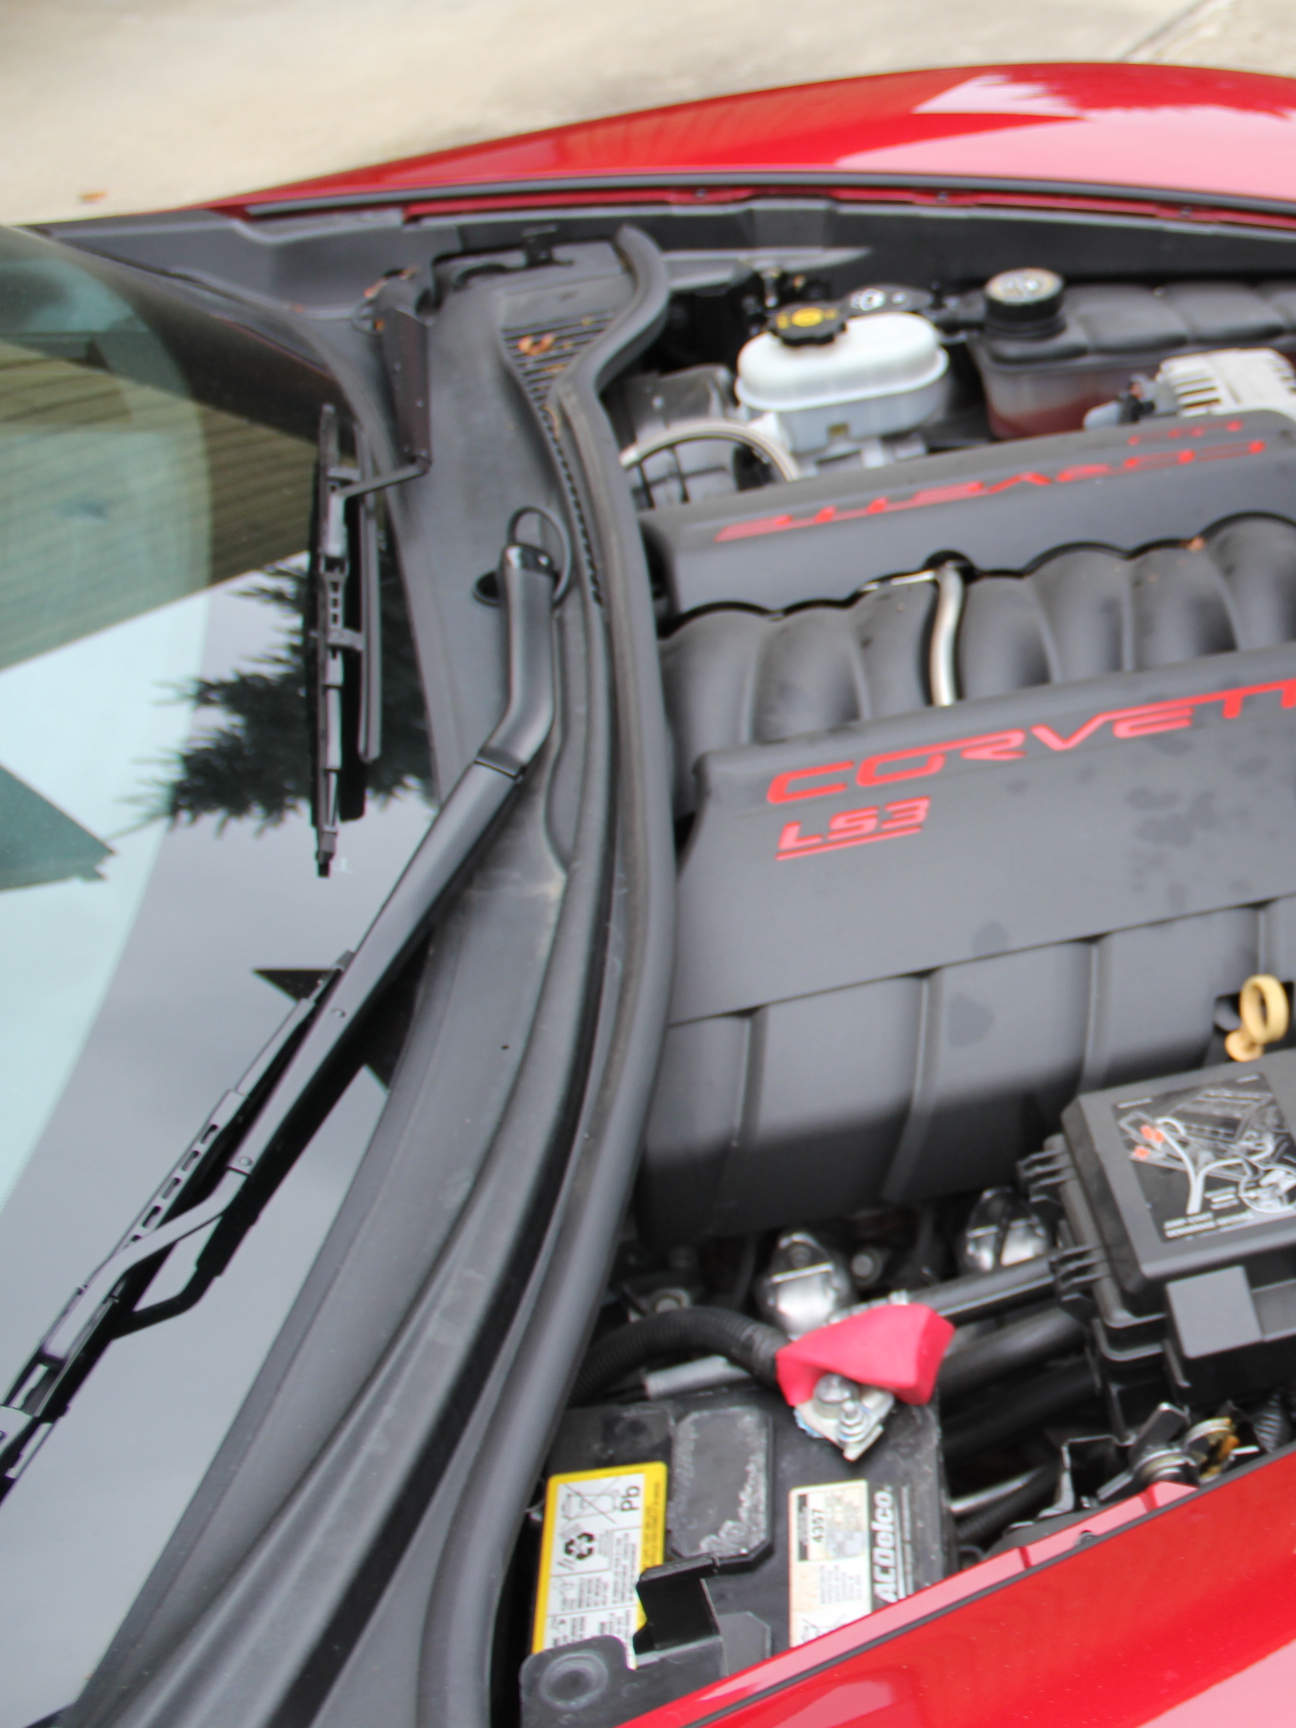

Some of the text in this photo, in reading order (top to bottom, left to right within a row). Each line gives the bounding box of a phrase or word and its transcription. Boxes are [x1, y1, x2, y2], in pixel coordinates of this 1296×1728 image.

[777, 797, 931, 854] LS3
[619, 1485, 641, 1512] Pb
[870, 1489, 899, 1604] ACDelco
